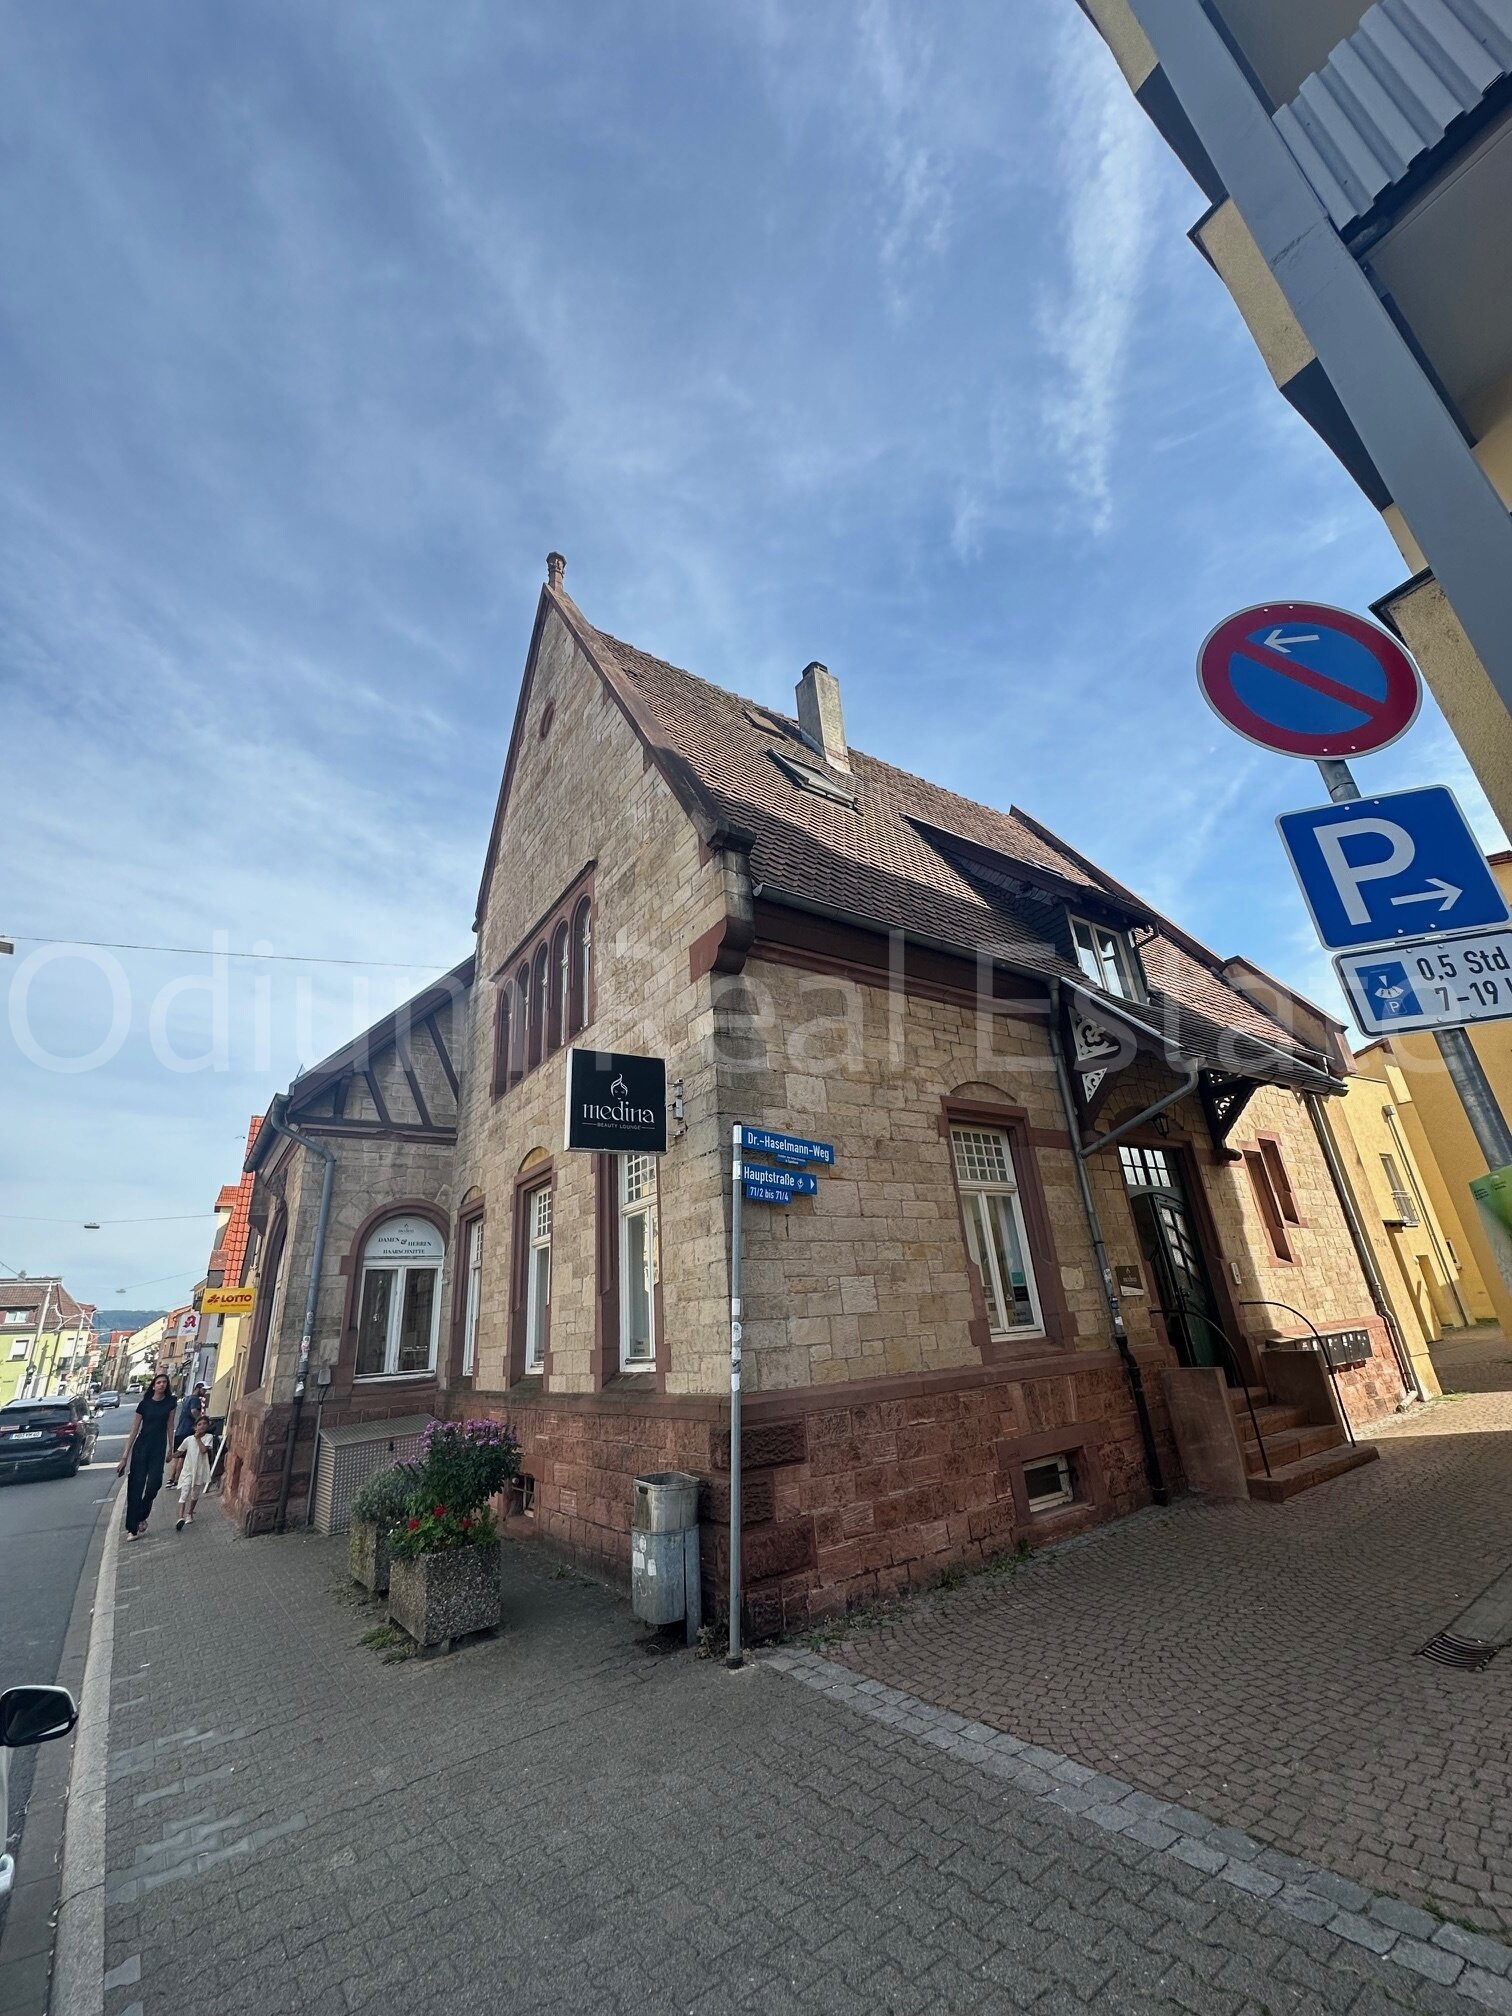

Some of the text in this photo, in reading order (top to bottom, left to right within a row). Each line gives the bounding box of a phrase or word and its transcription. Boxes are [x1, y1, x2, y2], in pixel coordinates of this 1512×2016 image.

[1312, 818, 1416, 925] P
[1416, 953, 1457, 982] 0,5
[582, 1100, 655, 1124] medina
[748, 1132, 830, 1162] Dr.-Haselmann-Weg
[744, 1166, 795, 1187] Hauptstraße
[750, 1186, 789, 1201] 71/2 bis 71/4
[221, 1294, 252, 1303] LOTTO
